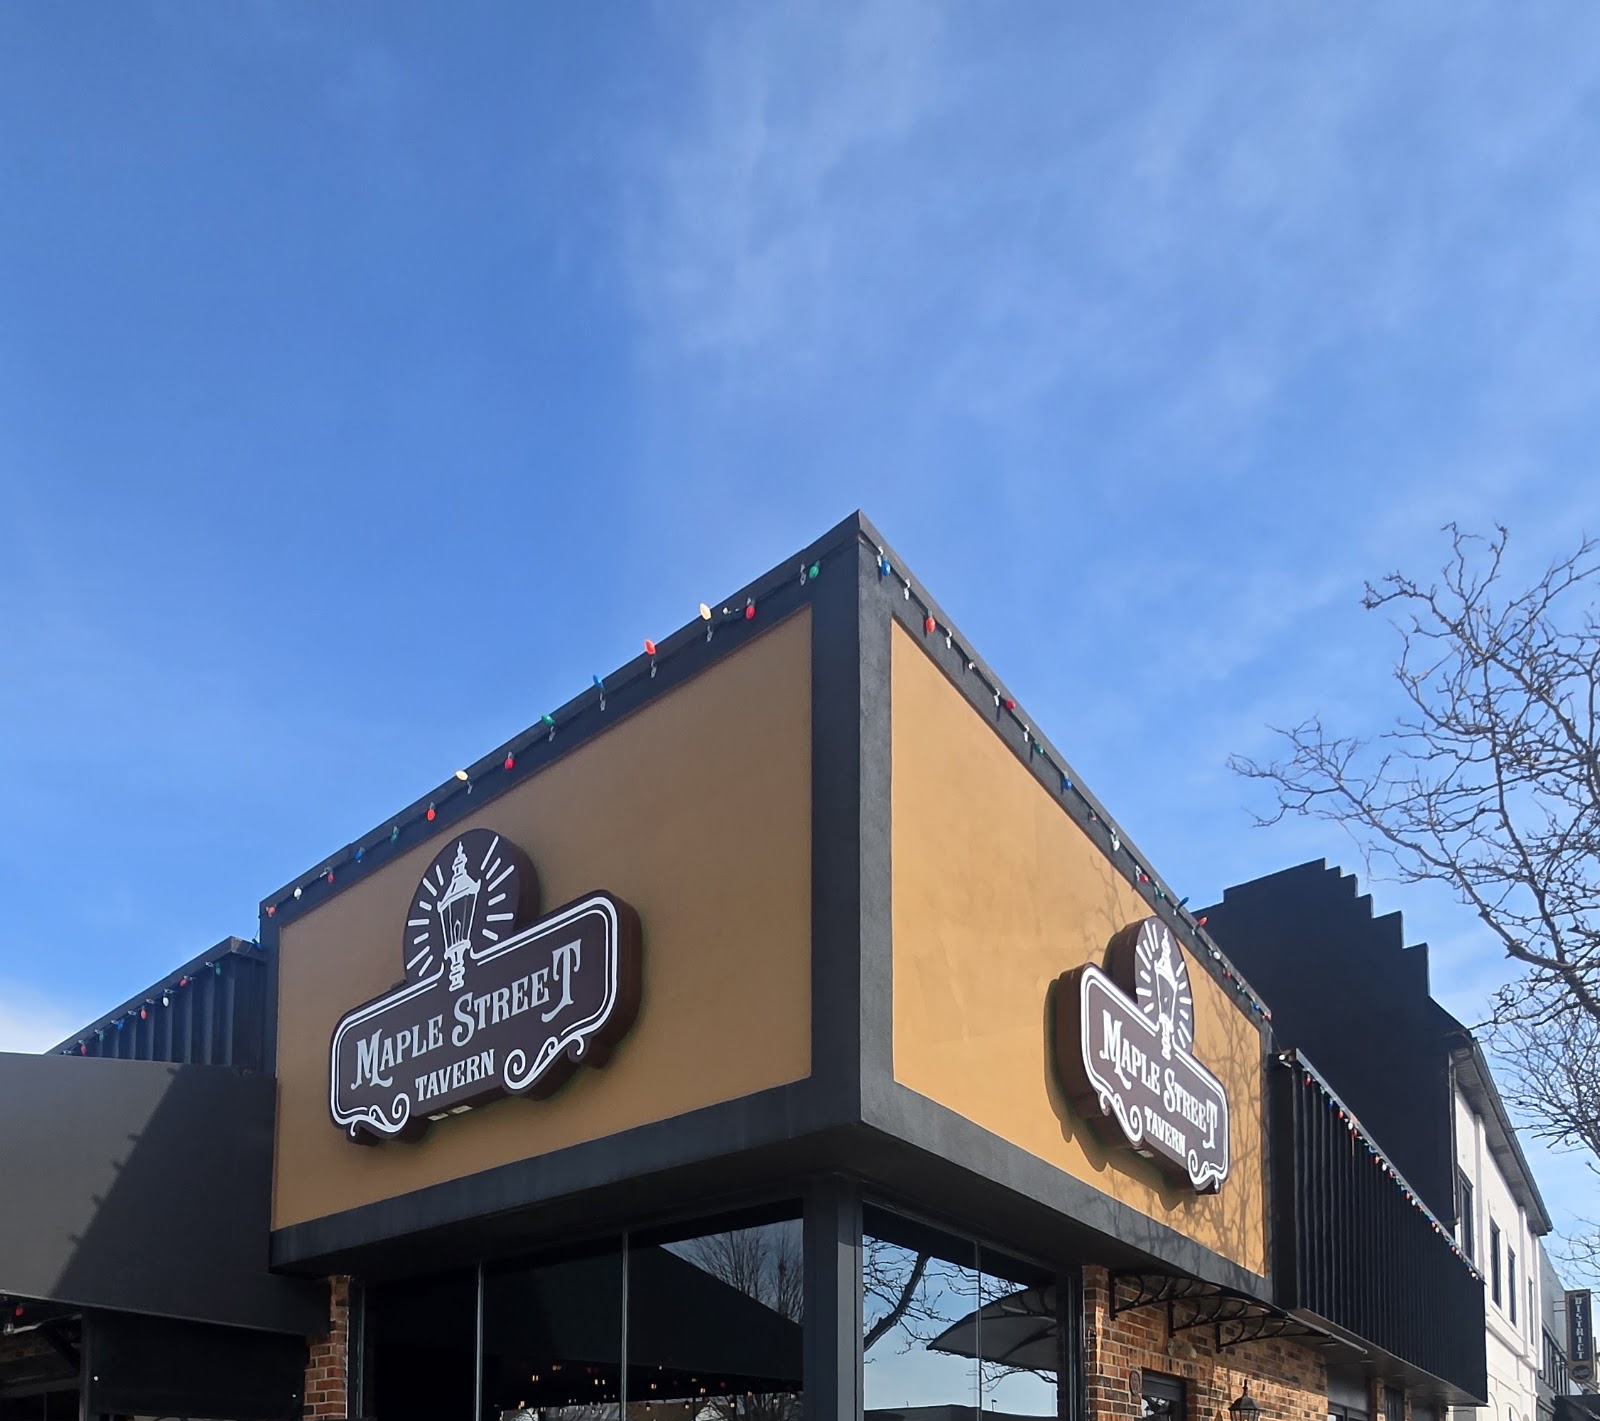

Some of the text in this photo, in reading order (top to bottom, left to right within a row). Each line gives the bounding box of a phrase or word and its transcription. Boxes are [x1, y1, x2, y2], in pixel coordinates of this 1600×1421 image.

[350, 939, 582, 1091] MAPLE STREET
[415, 1049, 495, 1102] TAVERN
[1099, 1009, 1218, 1149] MAPLE STREET
[1144, 1106, 1186, 1157] TAVERN
[1574, 1297, 1585, 1360] DISTRICT
